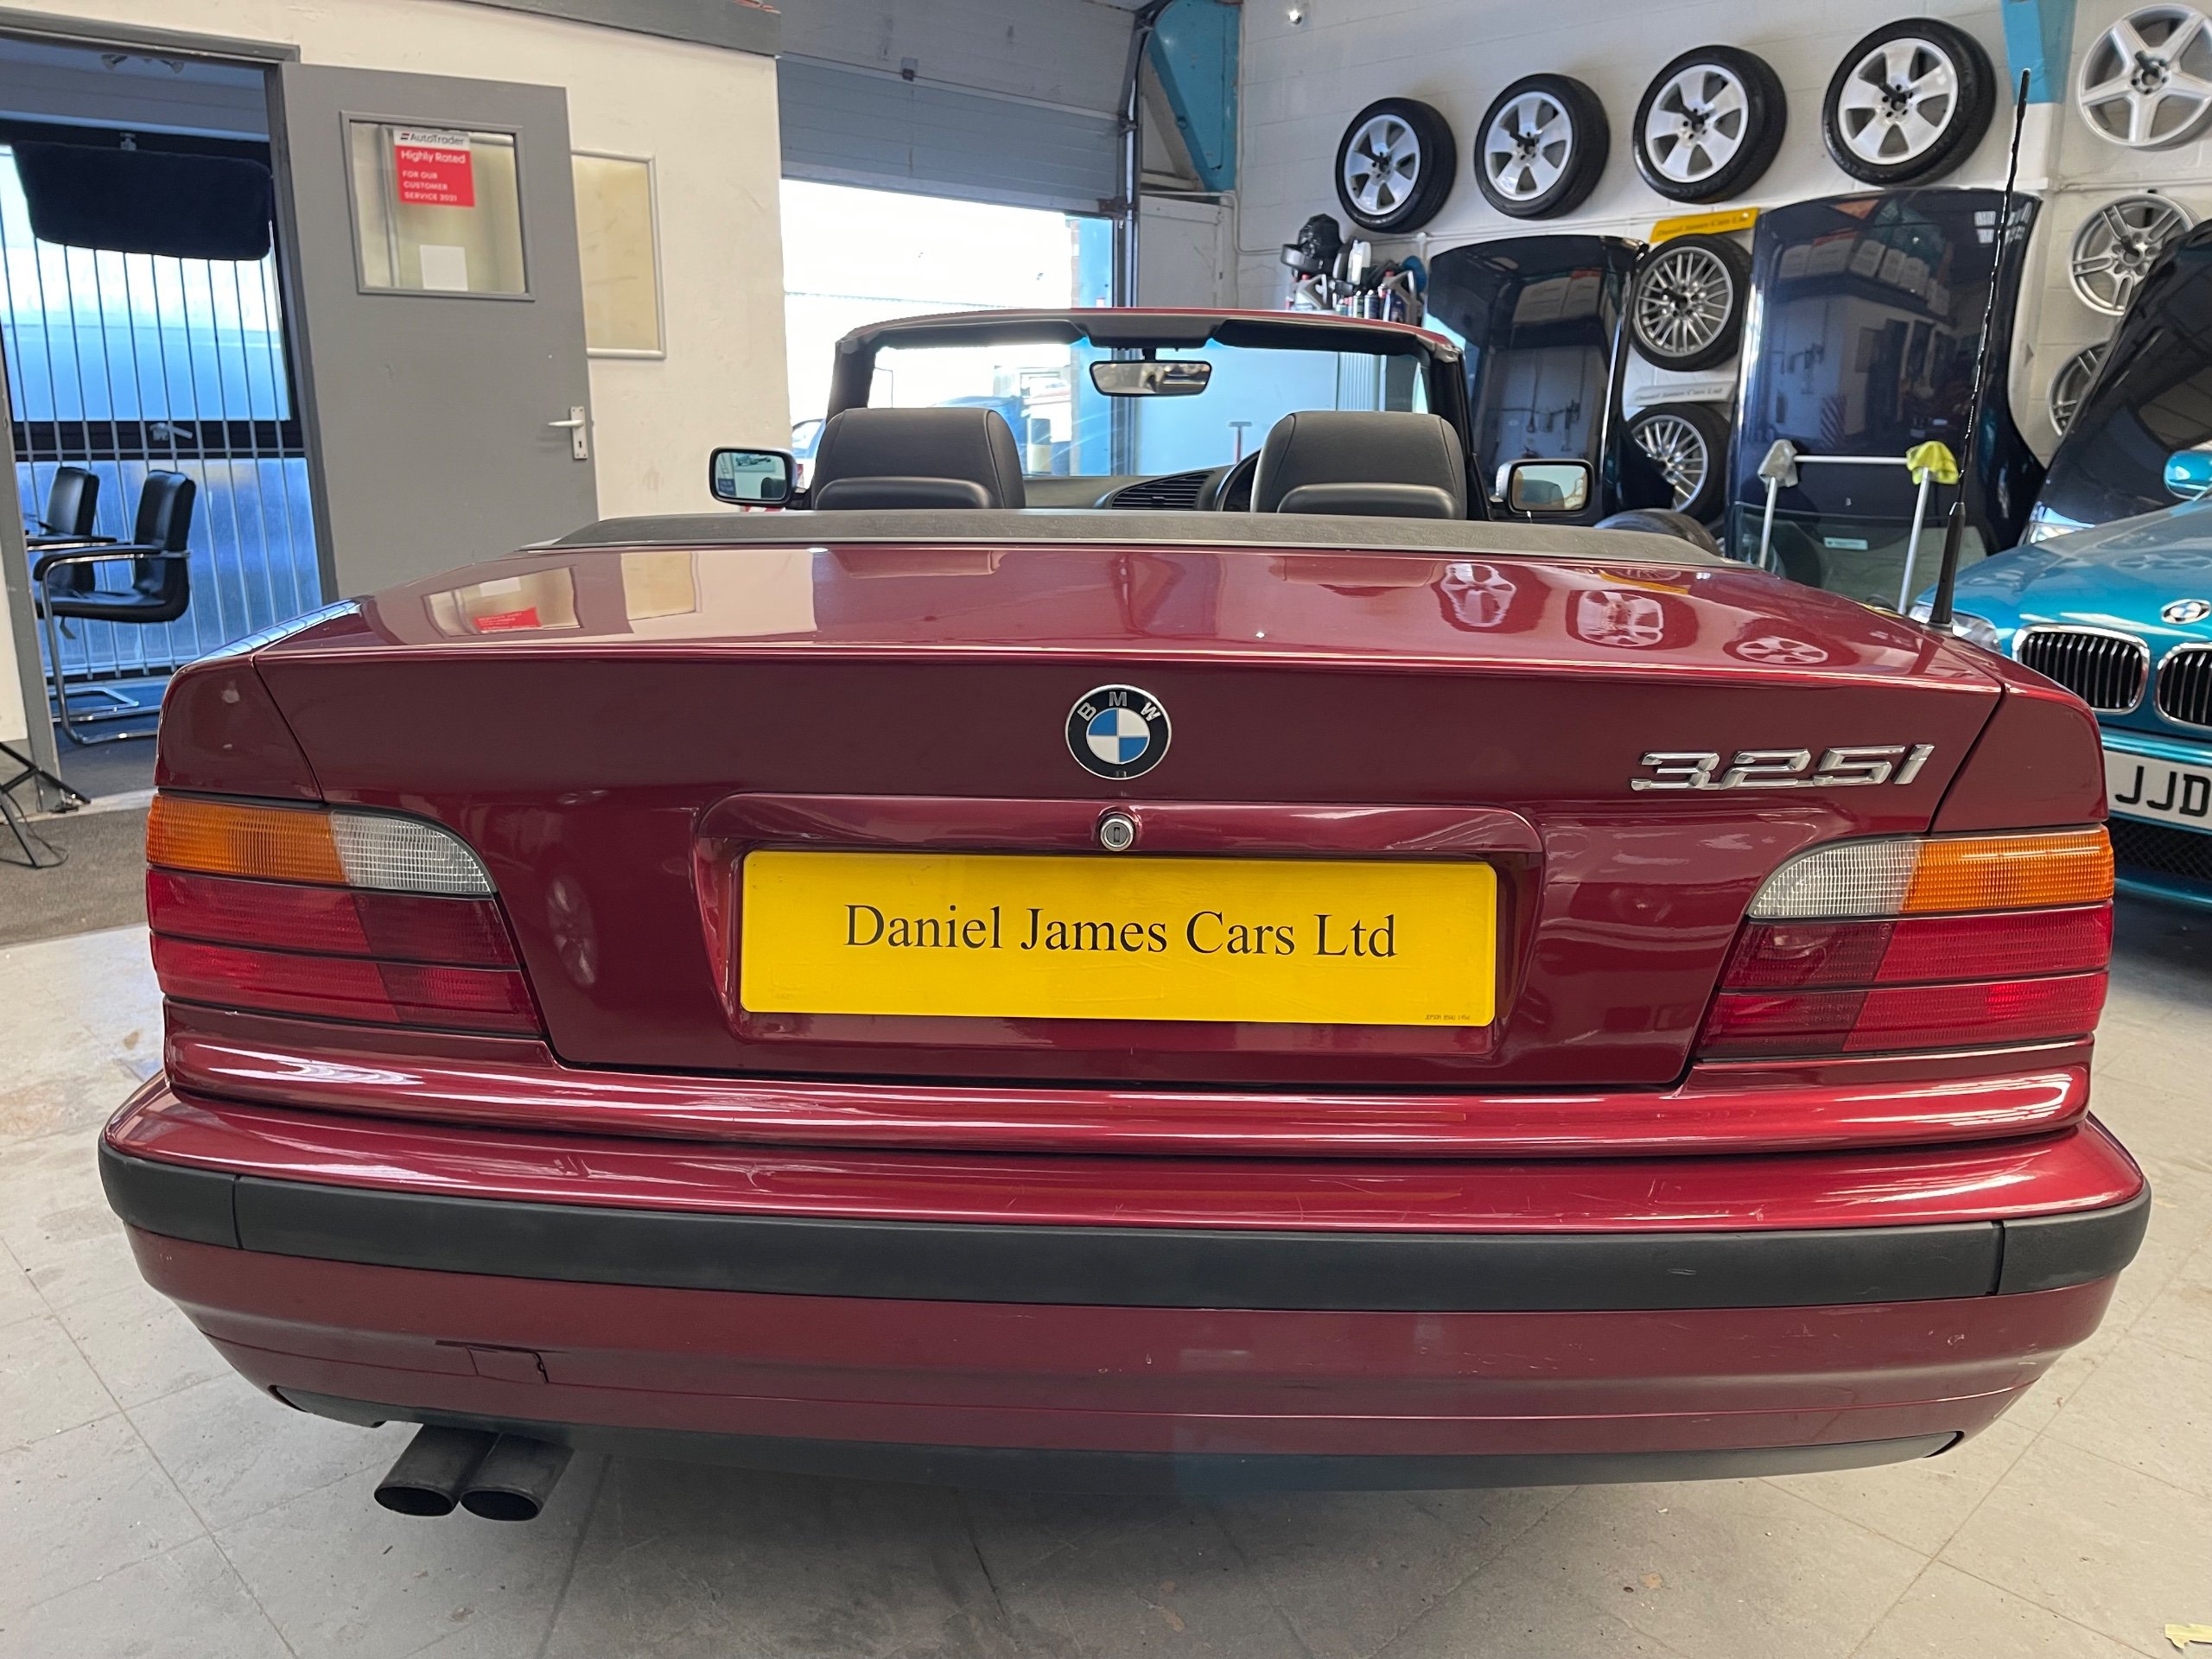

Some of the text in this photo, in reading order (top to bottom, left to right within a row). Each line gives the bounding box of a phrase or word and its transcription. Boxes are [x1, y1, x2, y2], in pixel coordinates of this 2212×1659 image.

[410, 133, 463, 145] AutoTrader
[401, 149, 466, 164] Highly Rated
[402, 169, 438, 180] FOR OUR
[403, 181, 448, 191] CUSTOMER
[404, 191, 458, 202] SERVICE 2021
[1077, 691, 1161, 721] BMW
[1630, 744, 1936, 791] 325i
[2114, 765, 2211, 817] JJD
[843, 904, 1398, 958] Daniel James Cars Ltd
